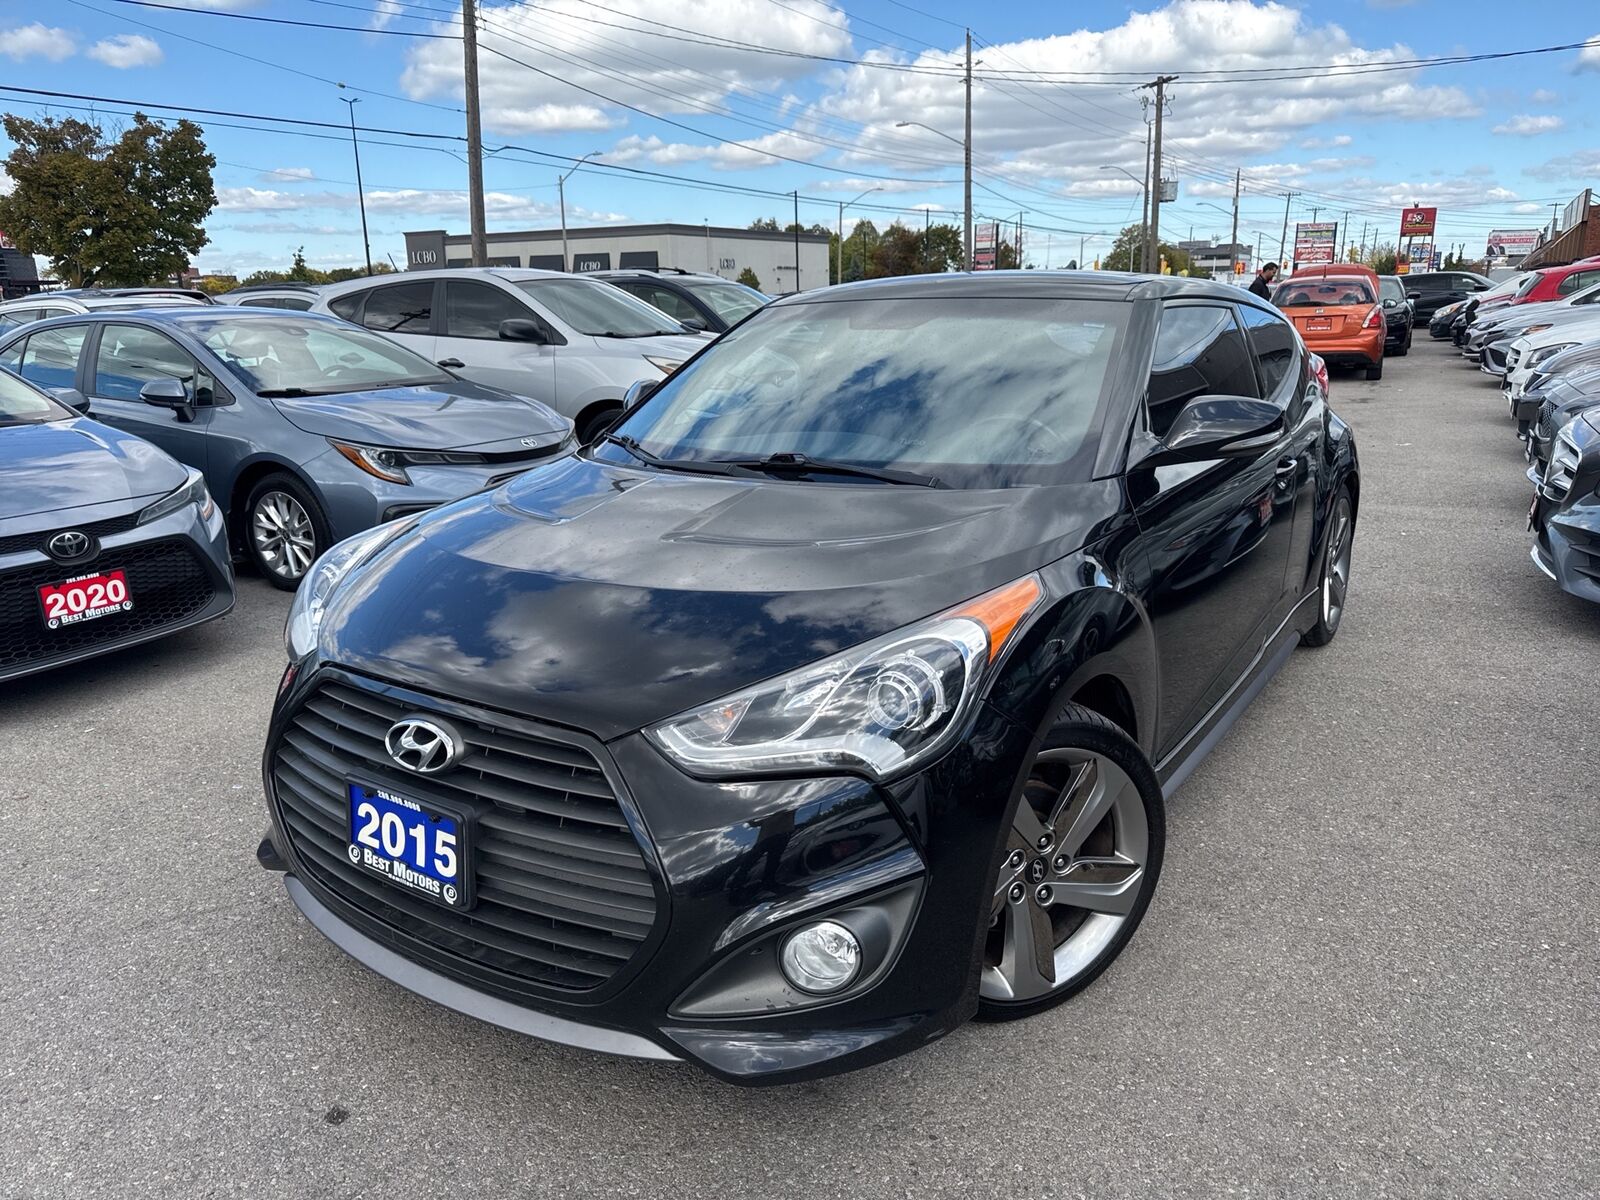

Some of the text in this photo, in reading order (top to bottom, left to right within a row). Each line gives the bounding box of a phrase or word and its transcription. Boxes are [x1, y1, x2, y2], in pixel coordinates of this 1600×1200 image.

[411, 250, 437, 264] LCBO
[719, 258, 736, 269] LCBO
[580, 261, 601, 271] LCBO
[46, 579, 126, 618] 2020
[85, 603, 121, 618] MOTORS
[357, 802, 457, 878] 2015
[363, 848, 440, 894] BEST MOTORS
